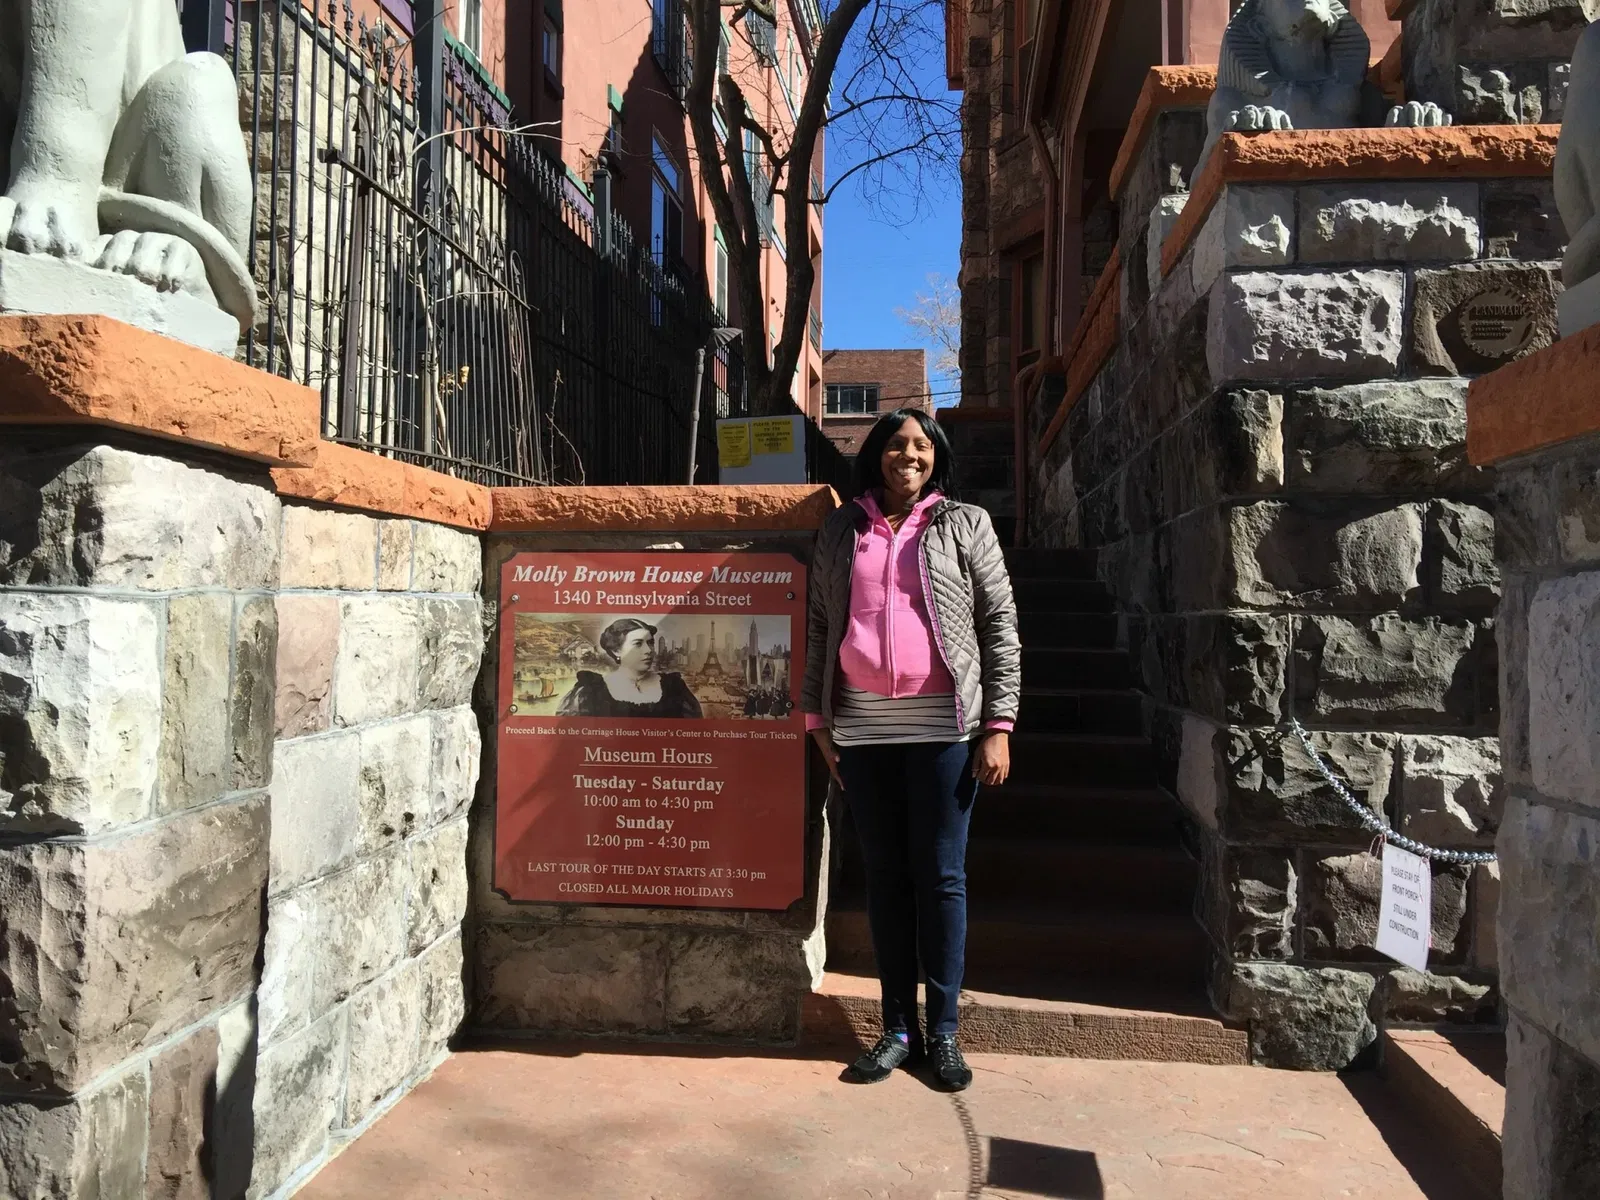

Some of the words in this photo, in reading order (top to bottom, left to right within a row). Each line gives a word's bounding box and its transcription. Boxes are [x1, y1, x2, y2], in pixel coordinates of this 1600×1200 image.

[1475, 304, 1526, 316] LANDMARK
[512, 565, 567, 584] Molly
[572, 565, 636, 583] Brown
[641, 566, 703, 583] House
[709, 566, 792, 584] Museum
[554, 590, 590, 605] 1340
[596, 591, 700, 608] Pennsylvania
[706, 592, 752, 606] Street
[505, 727, 535, 735] Proceed
[537, 727, 556, 735] Back
[581, 728, 614, 737] Carriage
[642, 729, 674, 737] Visitor's
[676, 730, 701, 738] Center
[713, 730, 747, 739] Purchase
[749, 731, 767, 739] Tour
[769, 732, 798, 740] Tickets
[584, 747, 656, 763] Museum
[662, 749, 713, 764] Hours
[573, 775, 636, 792] Tuesday
[652, 777, 724, 794] Saturday
[583, 795, 618, 807] 10:00
[622, 798, 641, 808] am
[645, 797, 658, 808] to
[662, 796, 690, 809] 4:30
[694, 800, 714, 812] pm
[616, 815, 675, 832] Sunday
[586, 835, 620, 847] 12:00
[625, 838, 644, 851] pm
[658, 836, 686, 849] 4:30
[690, 840, 710, 852] pm
[528, 862, 557, 873] LAST
[559, 863, 590, 874] TOUR
[594, 864, 610, 874] OF
[612, 865, 634, 875] THE
[637, 865, 662, 875] DAY
[664, 866, 706, 877] STARTS
[709, 868, 723, 877] AT
[727, 869, 747, 878] 3:30
[751, 870, 766, 880] pm
[1391, 866, 1403, 878] PLEASE
[1404, 870, 1413, 881] STAY
[559, 883, 604, 893] CLOSED
[606, 884, 629, 894] ALL
[632, 885, 671, 896] MAJOR
[675, 886, 734, 898] HOLIDAYS
[1392, 884, 1404, 896] FRONT
[1405, 888, 1419, 902] PORCH
[1393, 903, 1403, 916] STILL
[1403, 908, 1417, 921] UNDER
[1389, 919, 1419, 940] CONSTRUCTION
